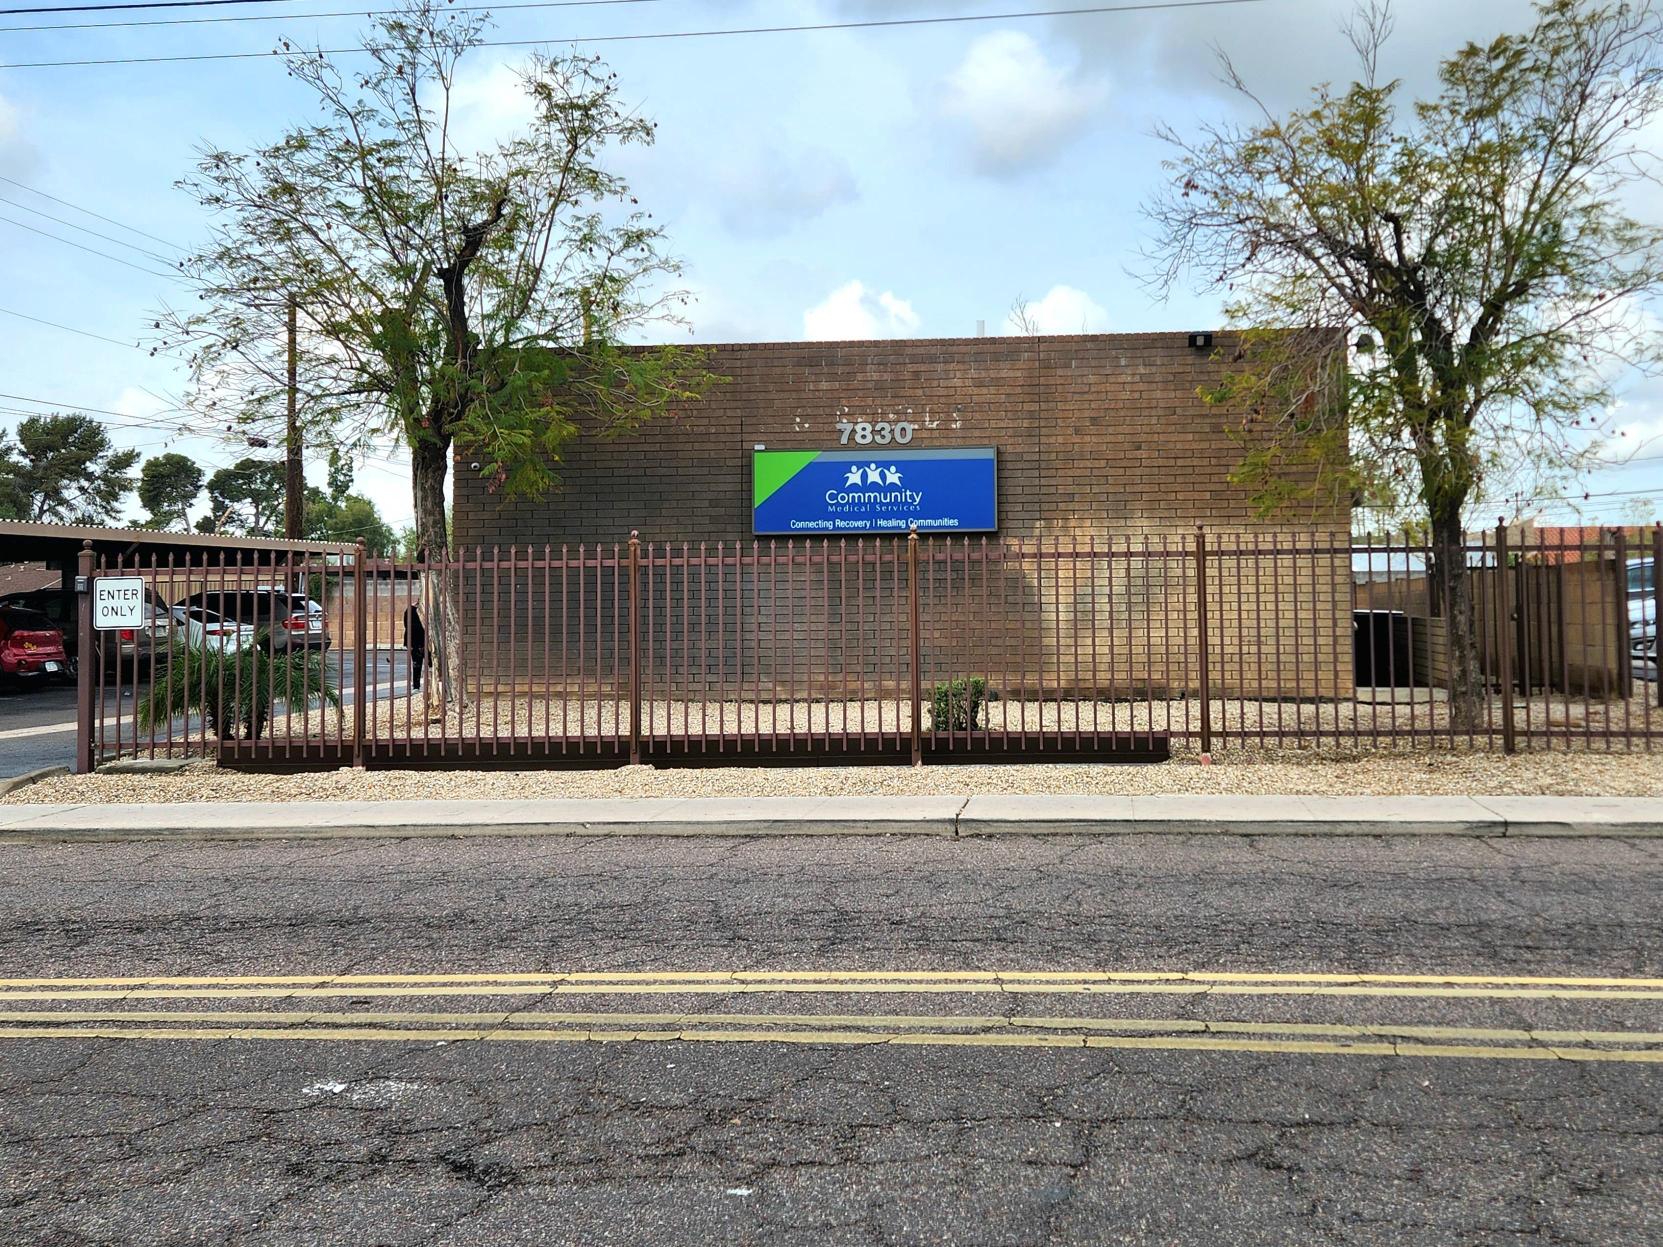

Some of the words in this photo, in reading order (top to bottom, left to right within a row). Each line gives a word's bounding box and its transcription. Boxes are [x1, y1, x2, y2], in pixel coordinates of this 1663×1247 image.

[836, 421, 914, 445] 7830
[825, 488, 922, 506] Community
[827, 504, 870, 512] Medical
[875, 504, 921, 512] Services
[790, 519, 833, 529] Connecting
[835, 519, 871, 529] Recovery
[877, 518, 906, 528] Healing
[908, 517, 959, 528] Communities
[99, 589, 139, 601] ENTER
[101, 605, 136, 617] ONLY
